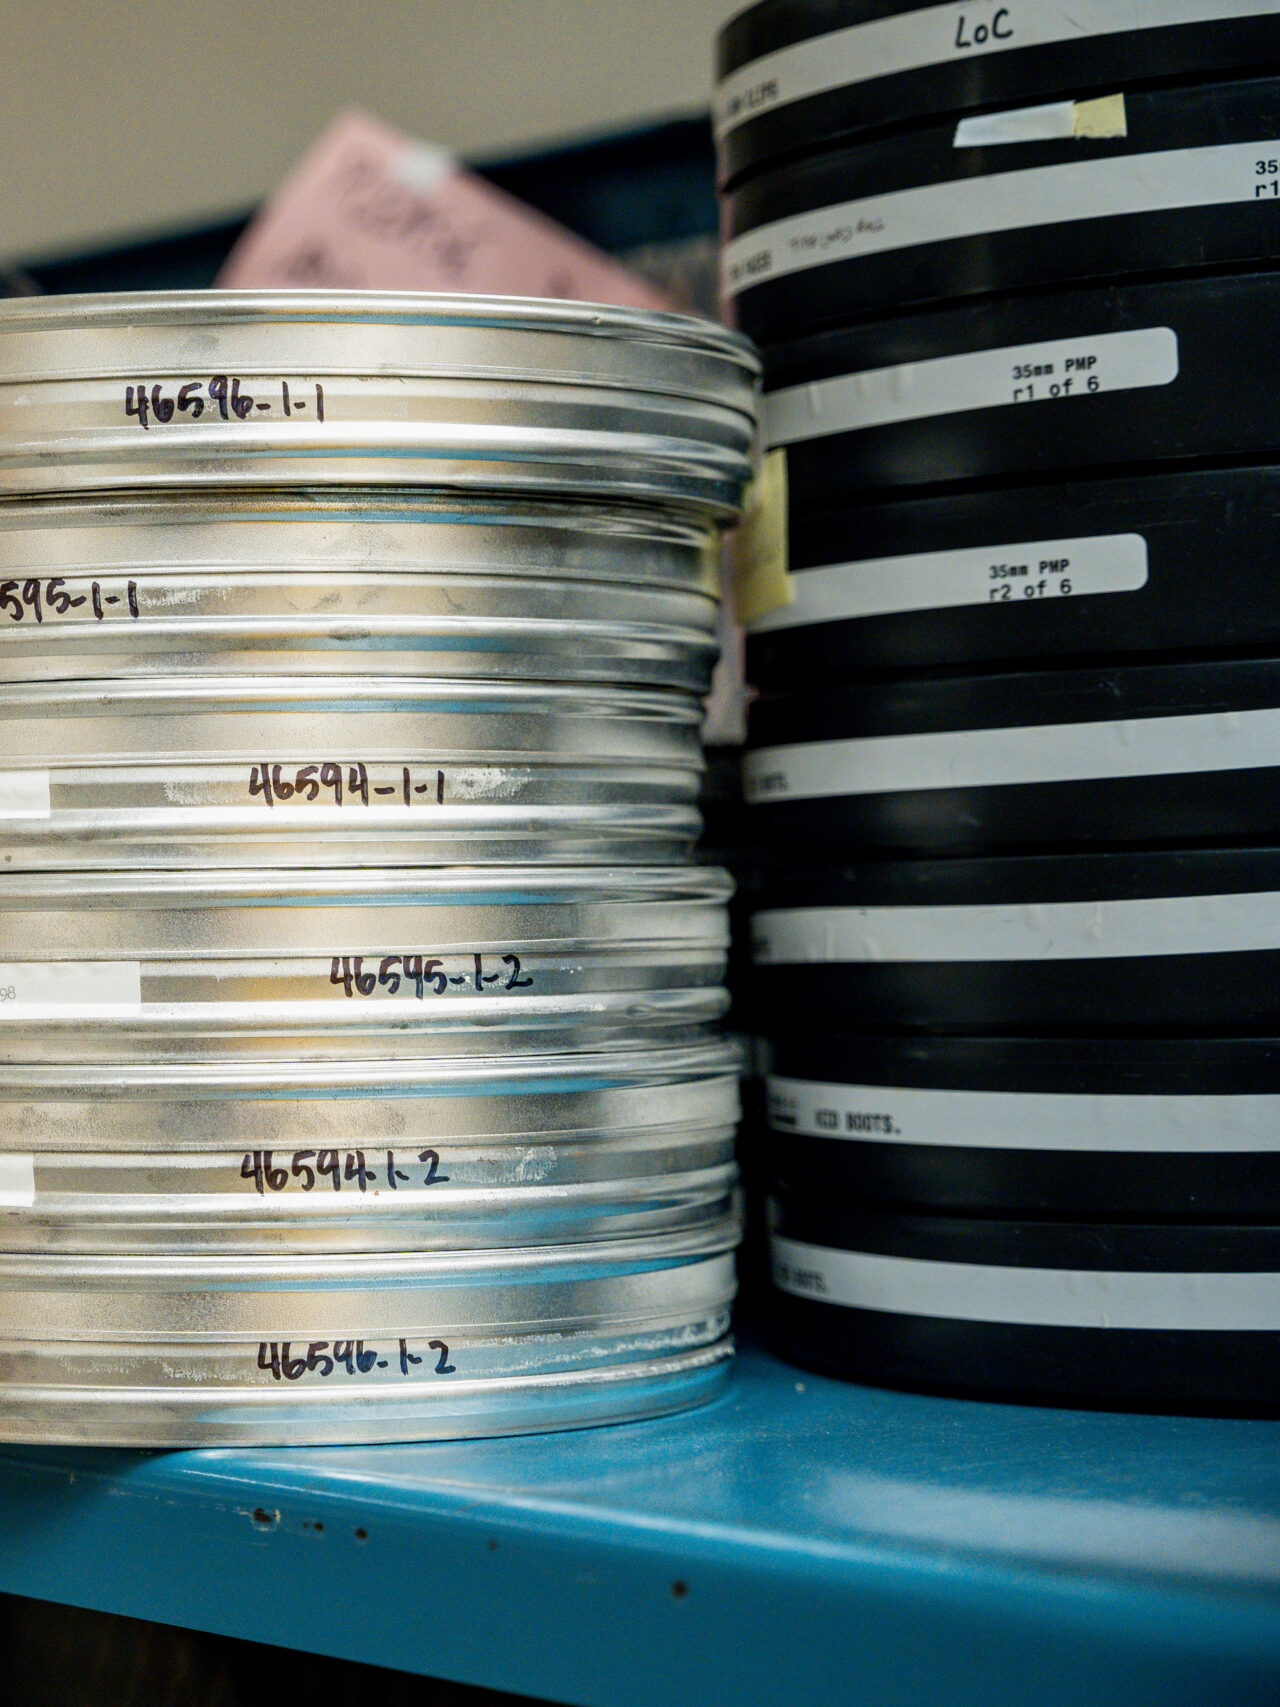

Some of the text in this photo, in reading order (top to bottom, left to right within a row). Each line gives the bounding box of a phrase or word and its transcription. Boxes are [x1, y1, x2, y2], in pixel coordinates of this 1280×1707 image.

[955, 7, 1014, 48] LoC
[1255, 179, 1278, 198] r1
[1012, 356, 1097, 380] 35mm PMP
[1013, 376, 1100, 402] r1 of 6
[125, 375, 325, 430] 46596-1-1
[989, 558, 1070, 579] 35mm PMP
[989, 578, 1072, 601] r2 of 6
[249, 762, 446, 807] 46594-1-1
